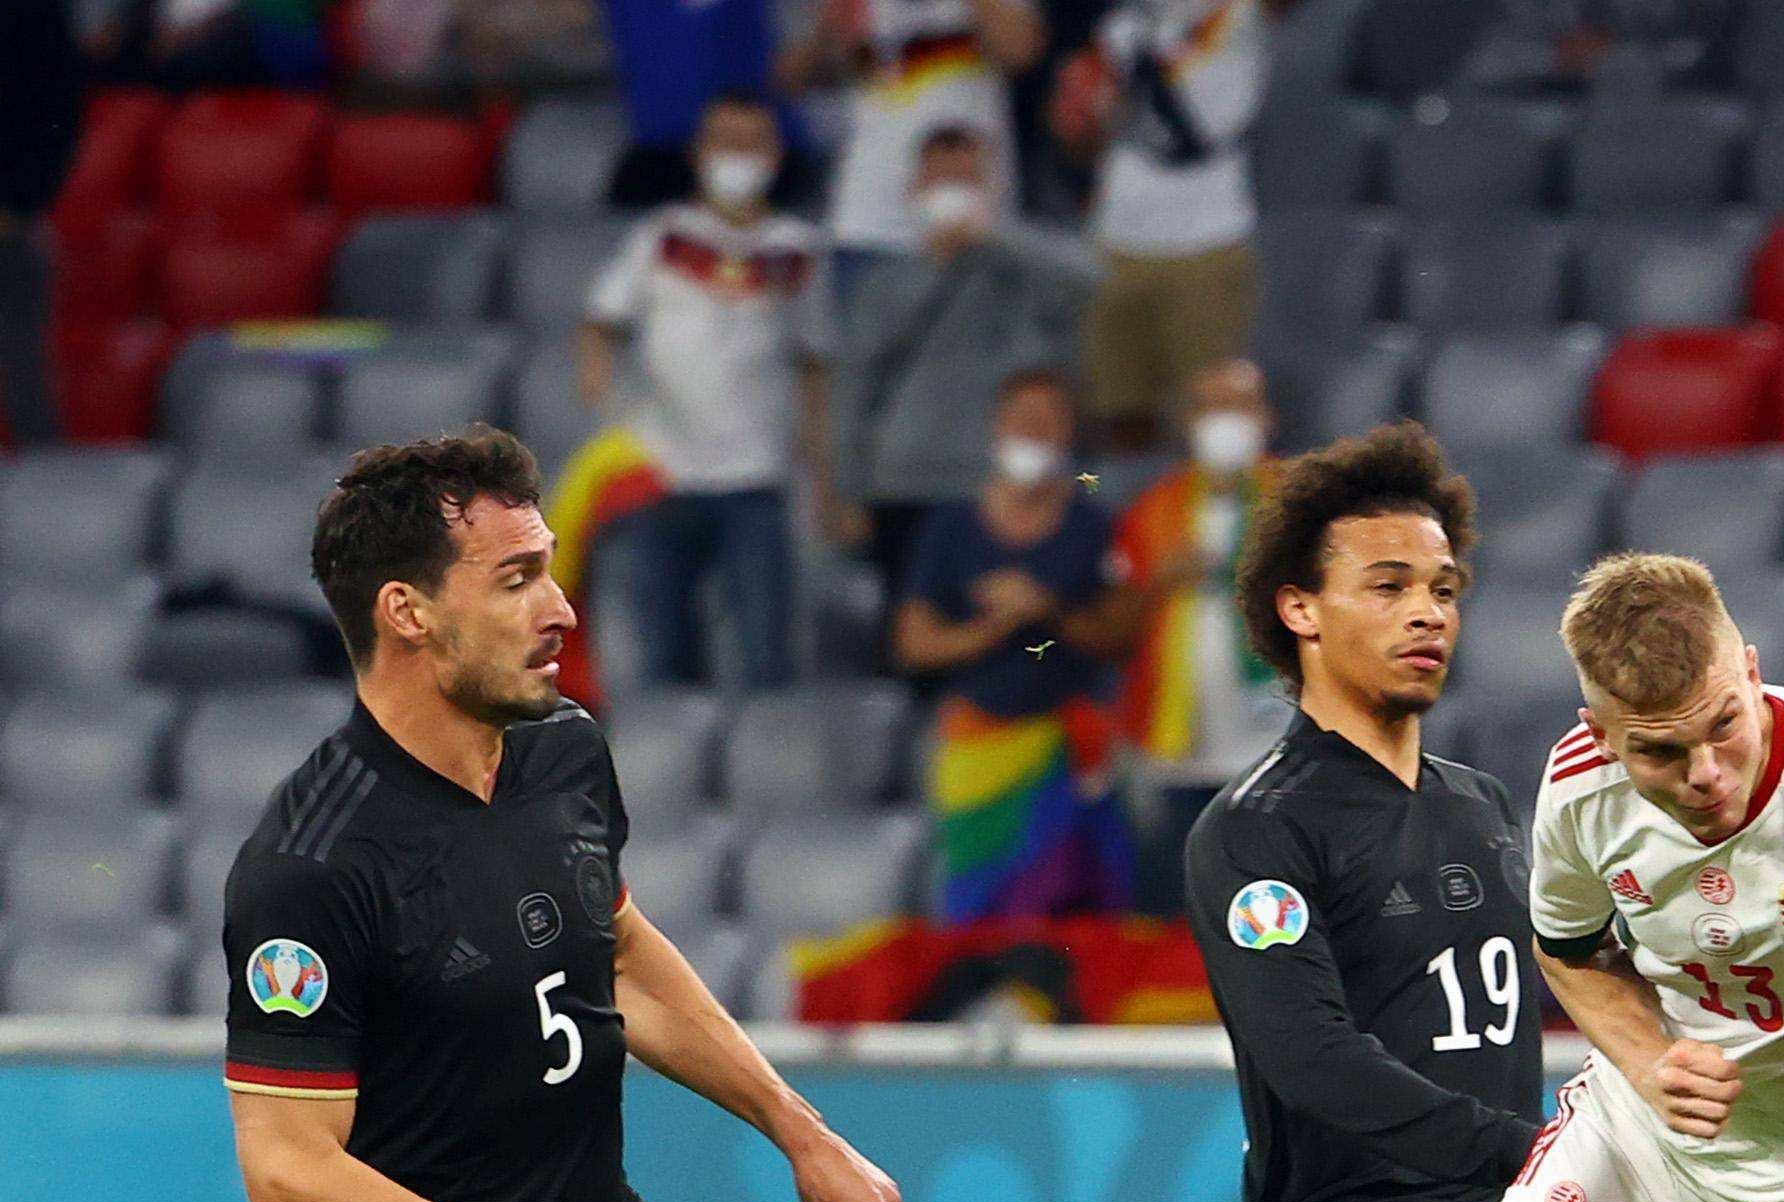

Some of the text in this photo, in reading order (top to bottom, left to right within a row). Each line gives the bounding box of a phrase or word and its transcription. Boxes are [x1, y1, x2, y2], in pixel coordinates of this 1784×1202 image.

[534, 970, 583, 1085] 5
[1426, 936, 1520, 1052] 19
[1682, 962, 1784, 1032] 13
